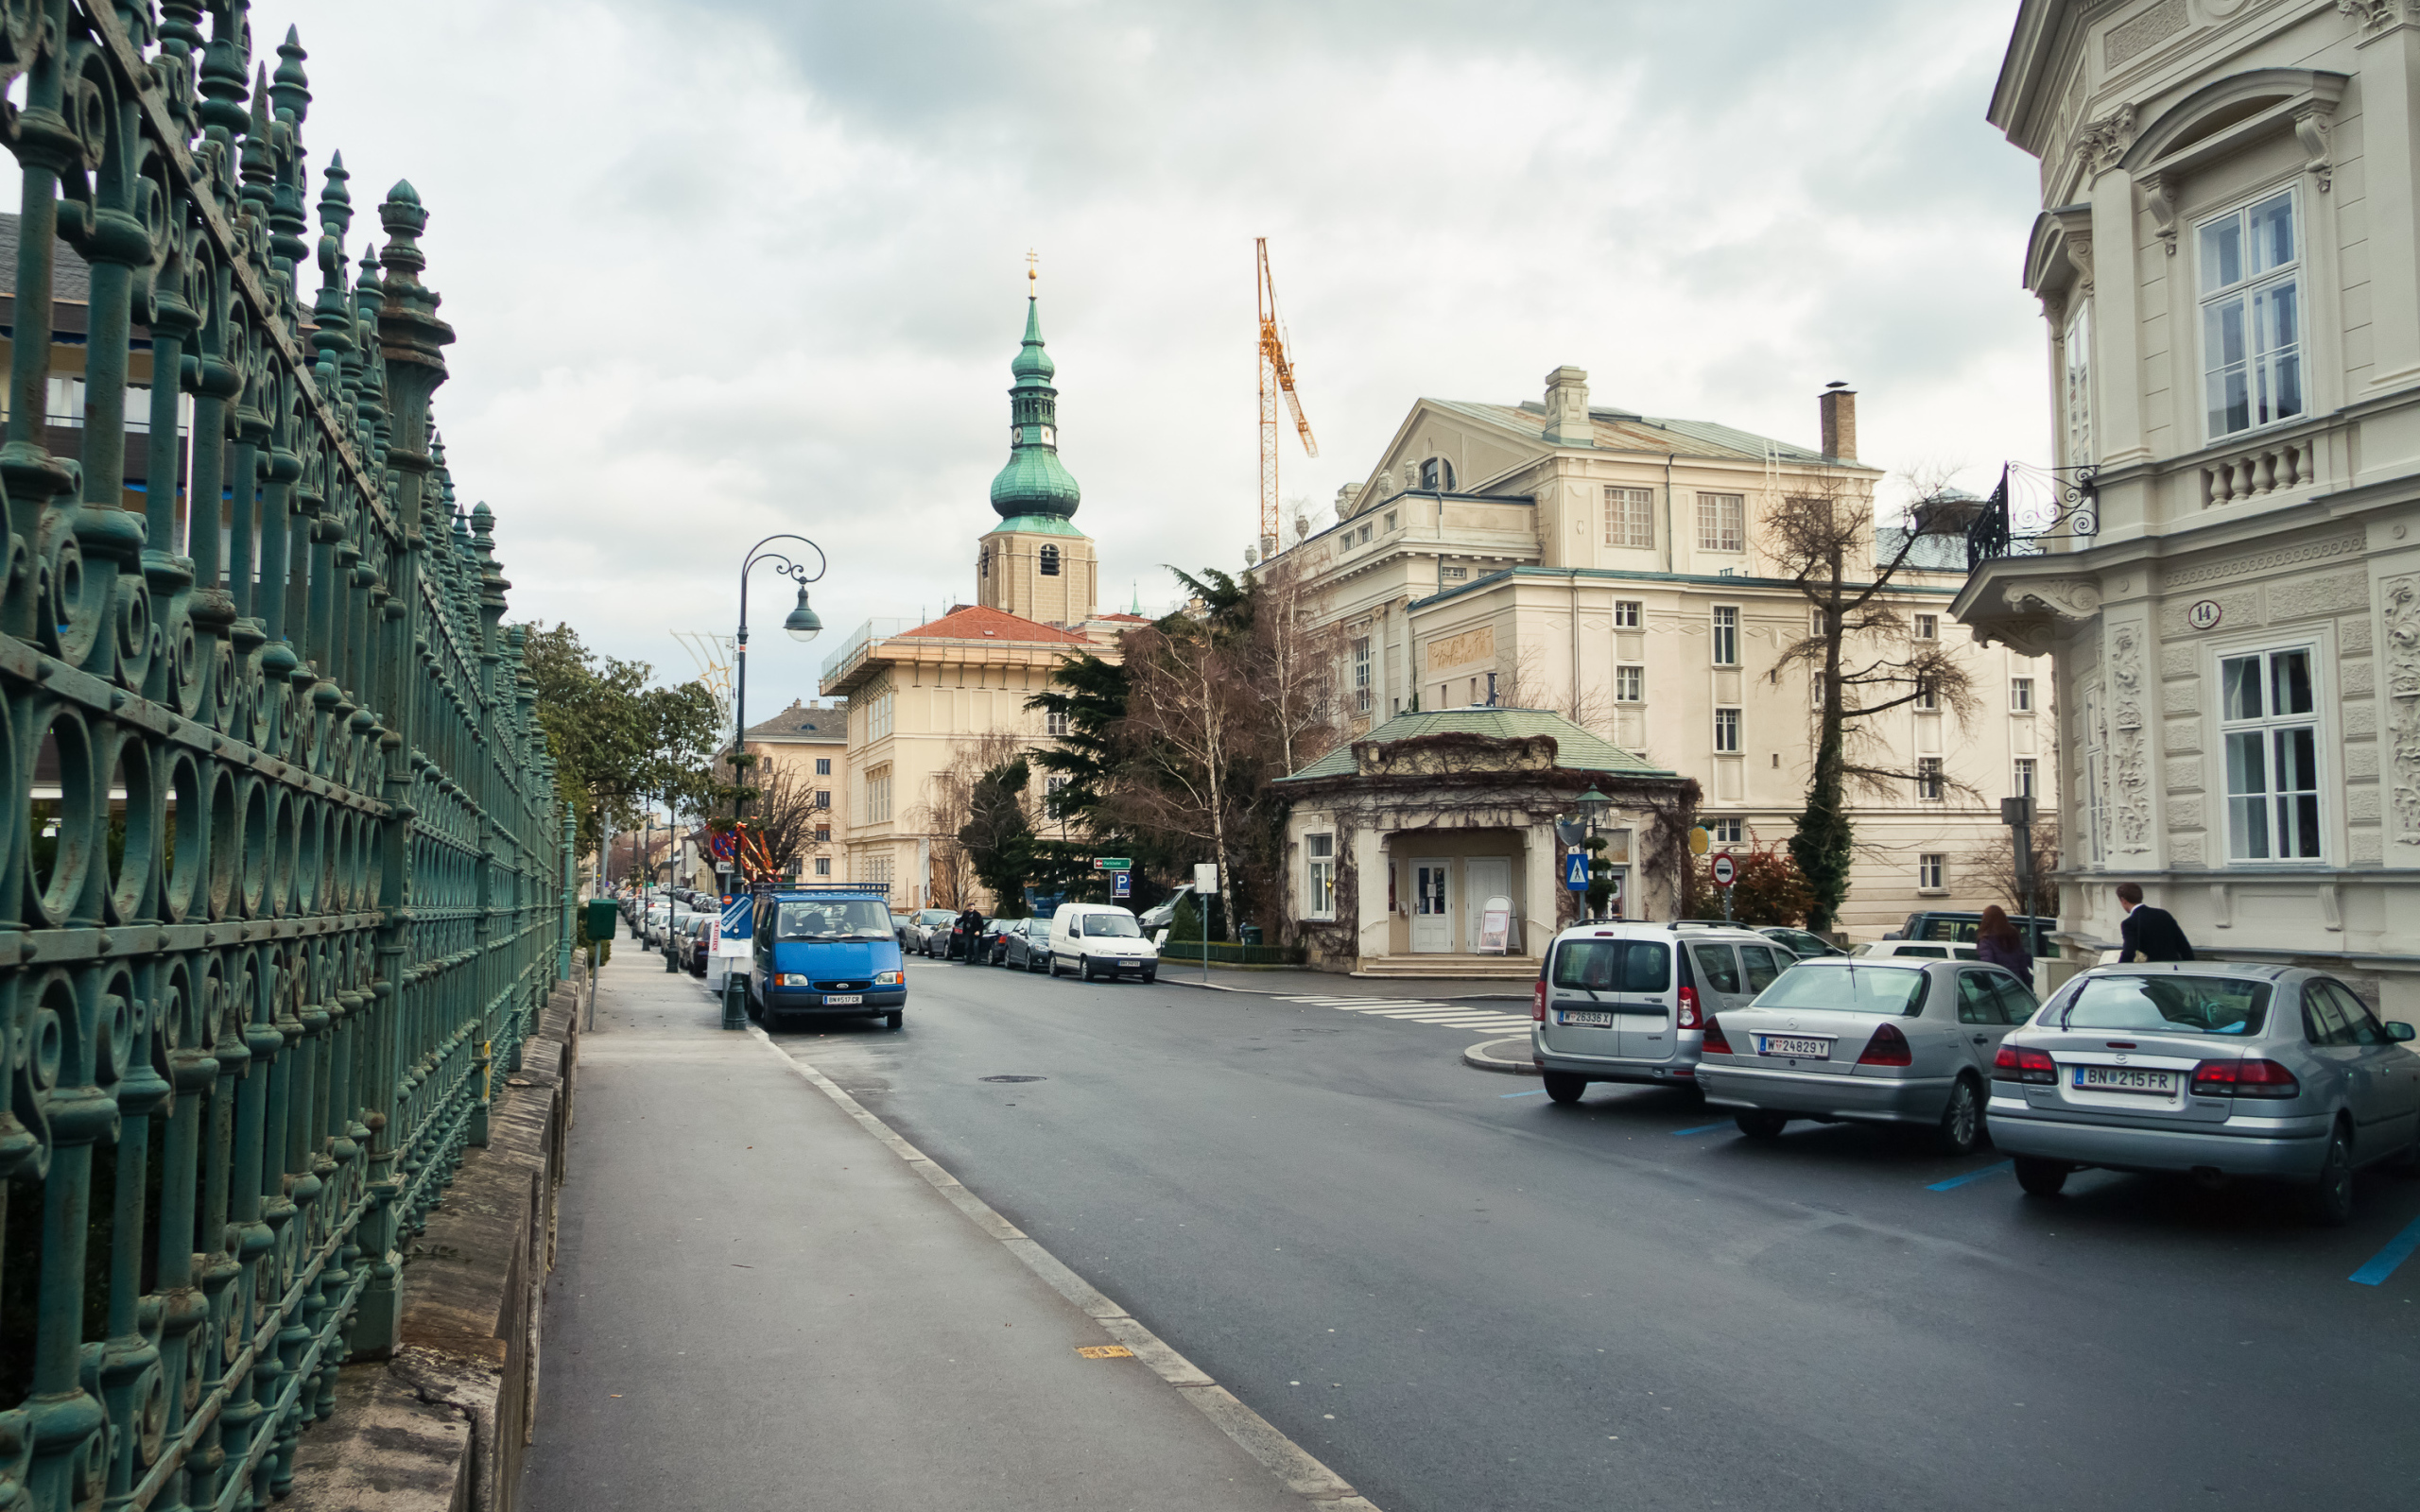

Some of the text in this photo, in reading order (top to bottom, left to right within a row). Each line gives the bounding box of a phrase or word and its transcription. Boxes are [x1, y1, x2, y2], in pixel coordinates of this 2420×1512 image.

[2197, 605, 2210, 621] 14
[1117, 875, 1127, 888] P
[1565, 1012, 1609, 1023] W 26336 X
[1768, 1040, 1825, 1054] W 24829 Y
[2088, 1069, 2106, 1084] BN
[2119, 1072, 2145, 1087] 215
[2149, 1074, 2168, 1089] FR
